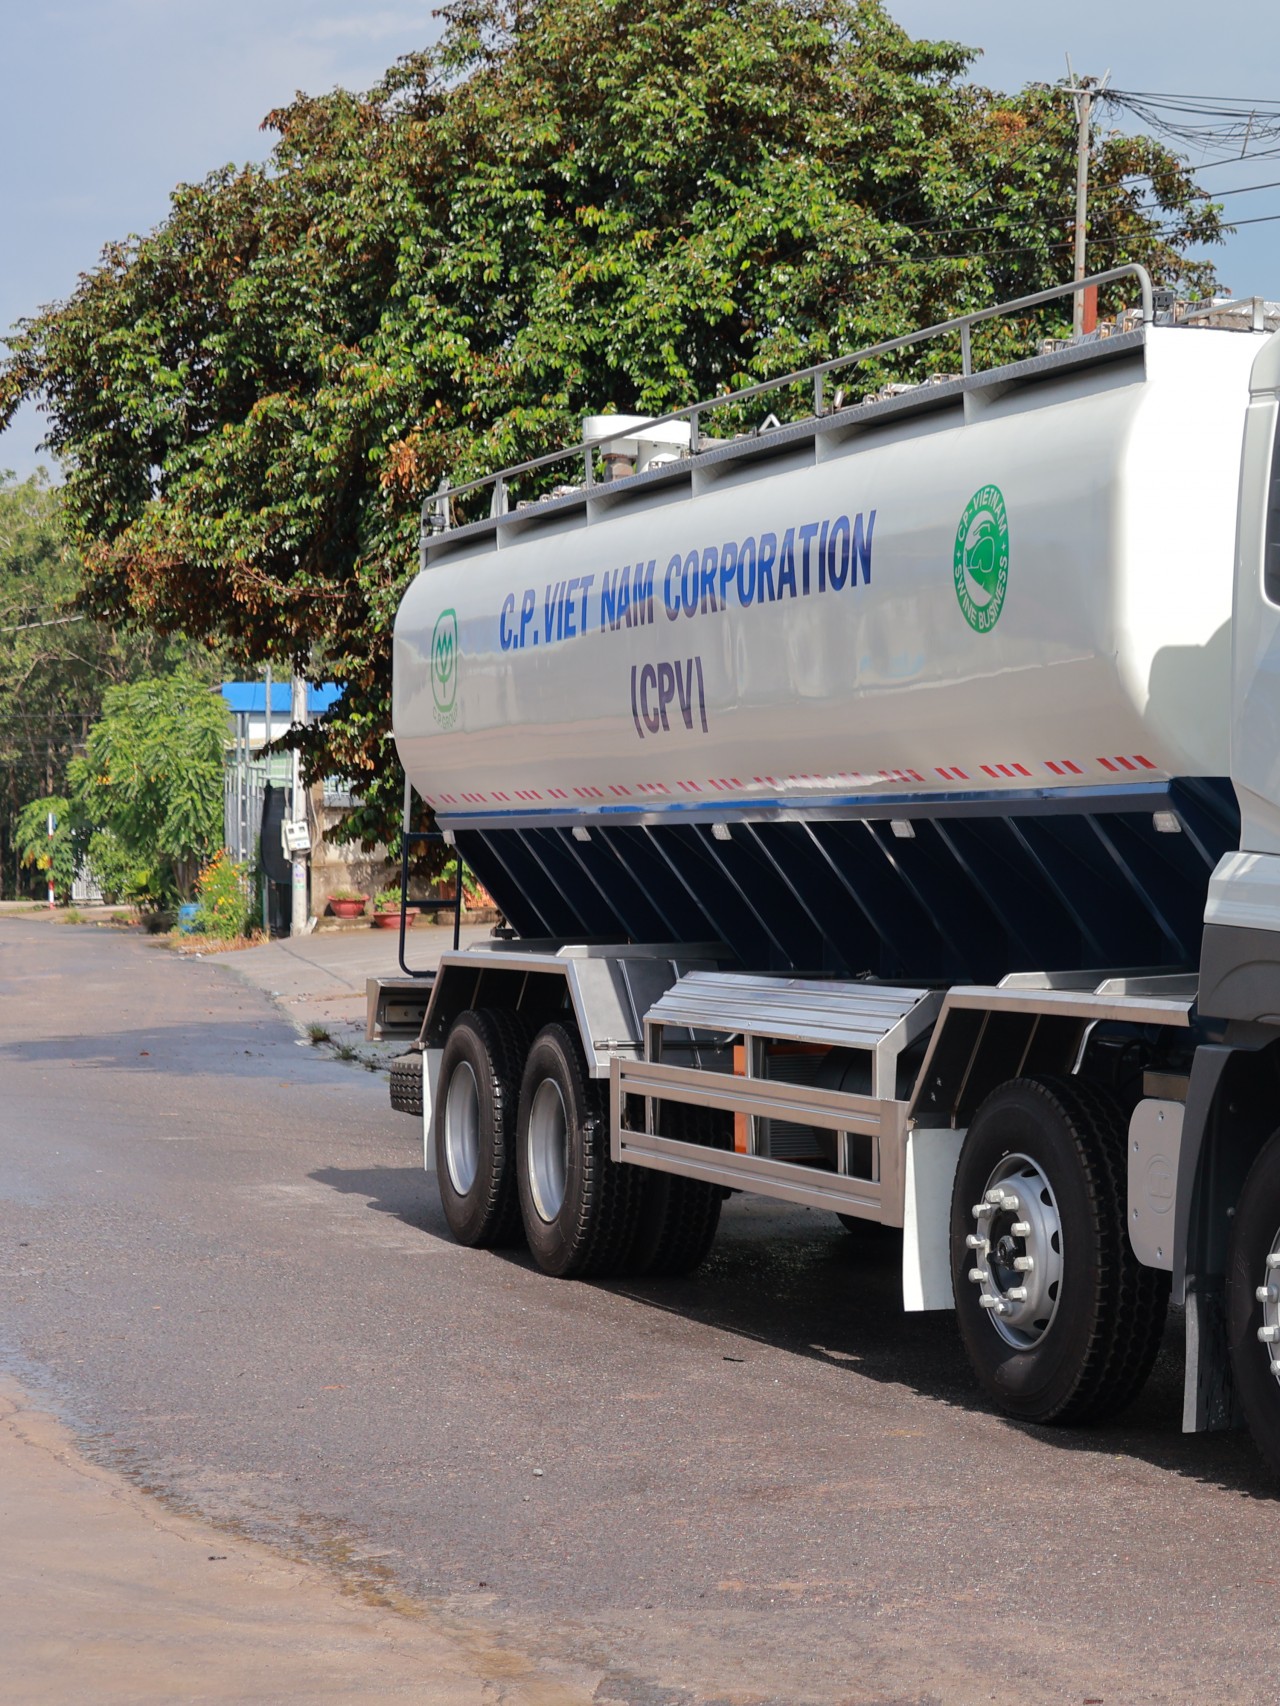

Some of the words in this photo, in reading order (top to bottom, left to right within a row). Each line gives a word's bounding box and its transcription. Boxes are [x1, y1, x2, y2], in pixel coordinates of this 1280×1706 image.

[544, 574, 595, 643] VIET
[601, 559, 656, 633] NAM
[664, 509, 877, 622] CORPORATION
[955, 563, 977, 626] SWINE
[978, 555, 1008, 630] BUSINESS
[630, 655, 709, 739] (CPV)
